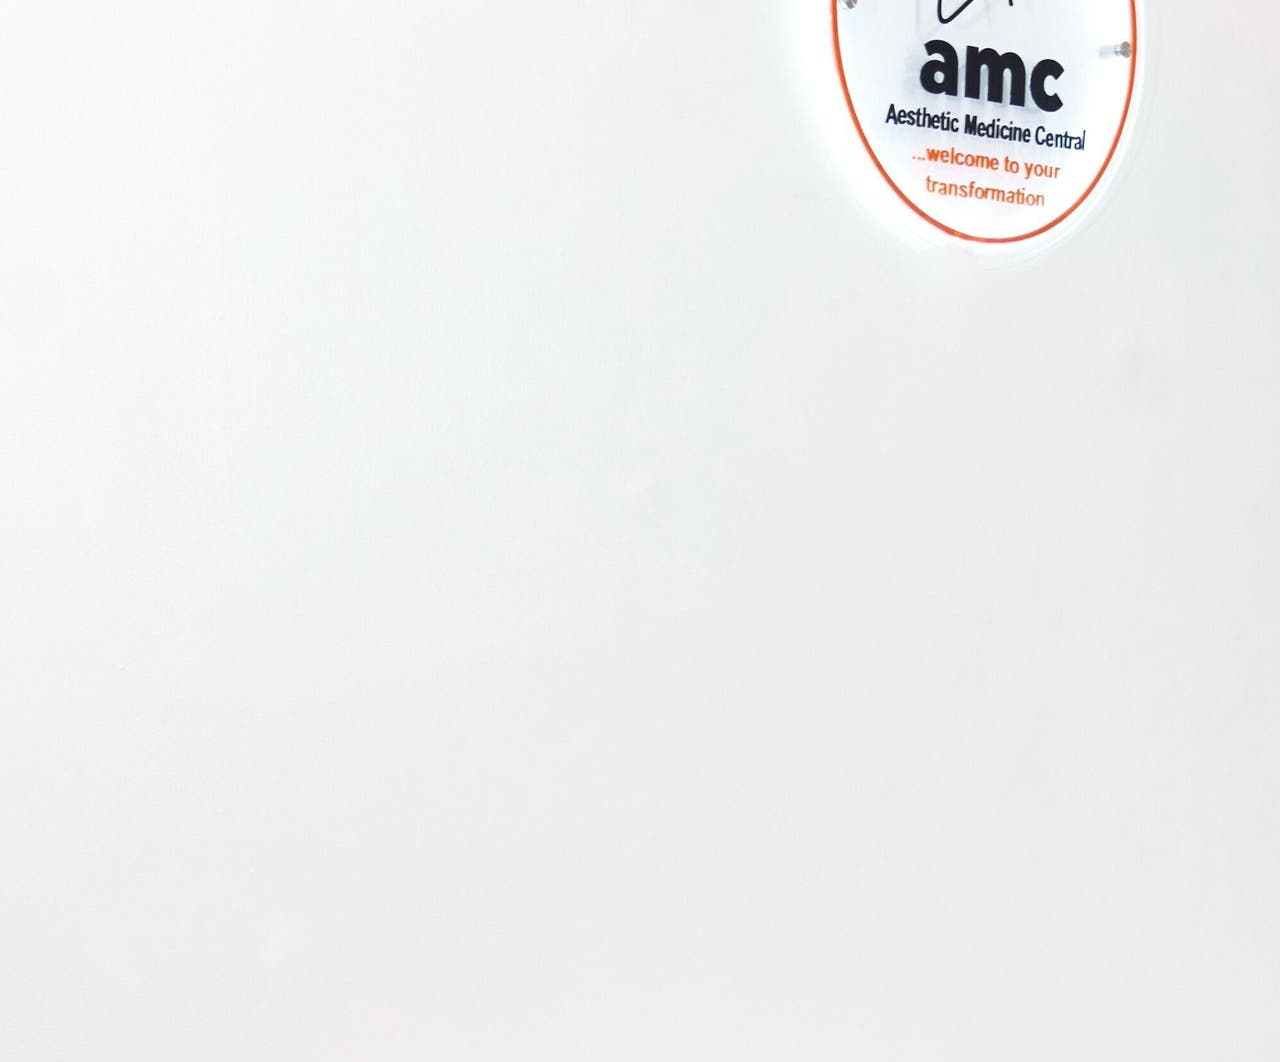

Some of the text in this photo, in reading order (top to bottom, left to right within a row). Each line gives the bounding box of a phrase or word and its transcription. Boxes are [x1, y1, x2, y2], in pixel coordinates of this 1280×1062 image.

[920, 39, 1064, 113] amc
[885, 103, 1086, 151] Aesthetic Medicine Central
[1004, 155, 1020, 174] to
[1024, 161, 1061, 180] your
[925, 175, 1045, 207] transformation
